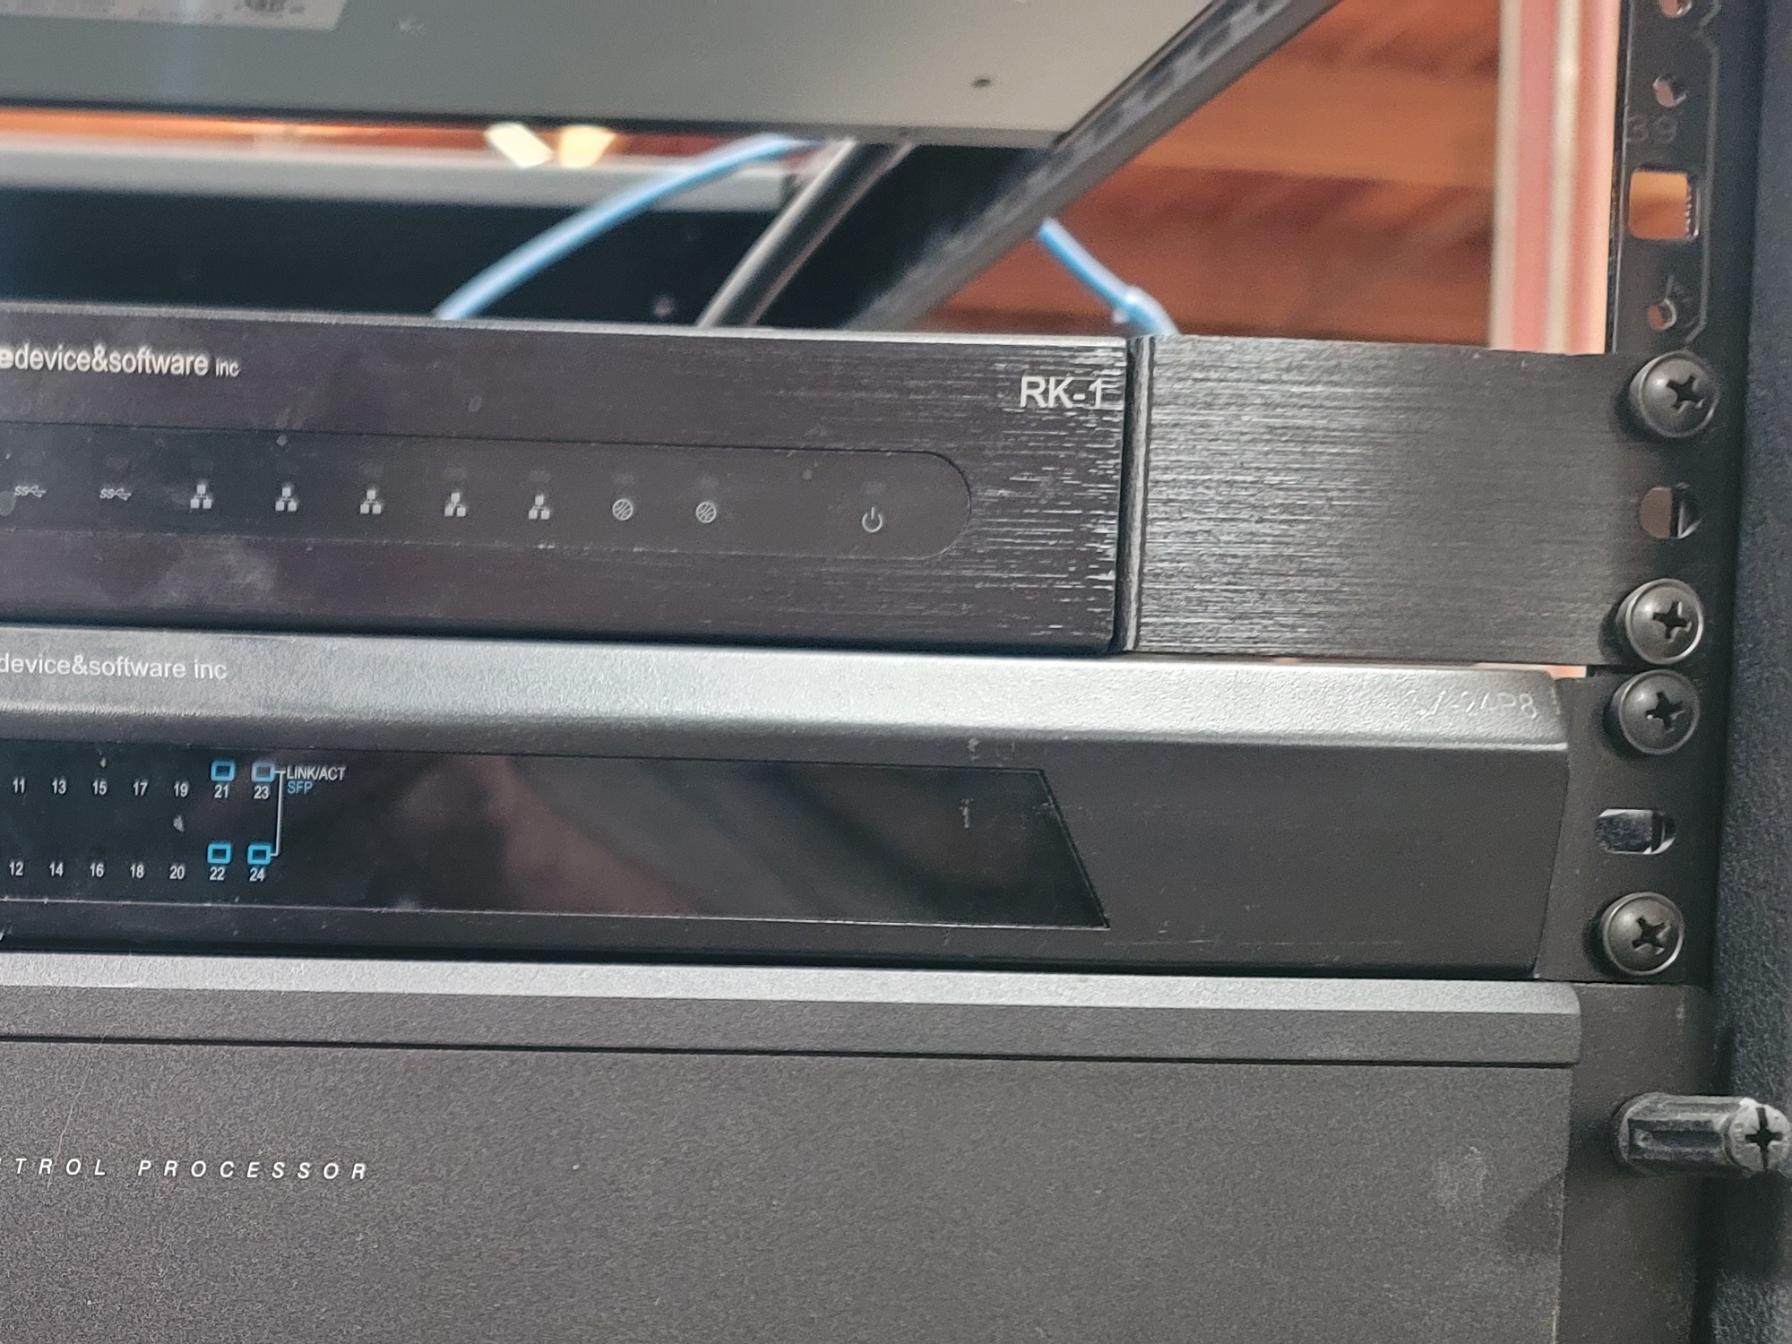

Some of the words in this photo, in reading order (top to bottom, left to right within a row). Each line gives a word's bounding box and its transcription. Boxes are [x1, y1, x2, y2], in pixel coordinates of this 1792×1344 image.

[215, 358, 240, 377] inc
[1019, 375, 1103, 409] RK-1
[193, 658, 228, 680] inc
[286, 765, 346, 780] LINK/ACT
[12, 777, 25, 793] 11
[52, 779, 67, 794] 13
[92, 779, 108, 795] 15
[133, 780, 148, 796] 17
[173, 782, 189, 798] 19
[214, 783, 229, 799] 21
[253, 784, 270, 800] 23
[287, 780, 313, 795] SFP
[9, 861, 24, 876] 12
[49, 862, 64, 877] 14
[89, 862, 105, 878] 16
[130, 863, 145, 879] 18
[169, 864, 185, 880] 20
[209, 866, 226, 881] 22
[249, 867, 265, 882] 24
[137, 1159, 366, 1180] PROCESSOR
